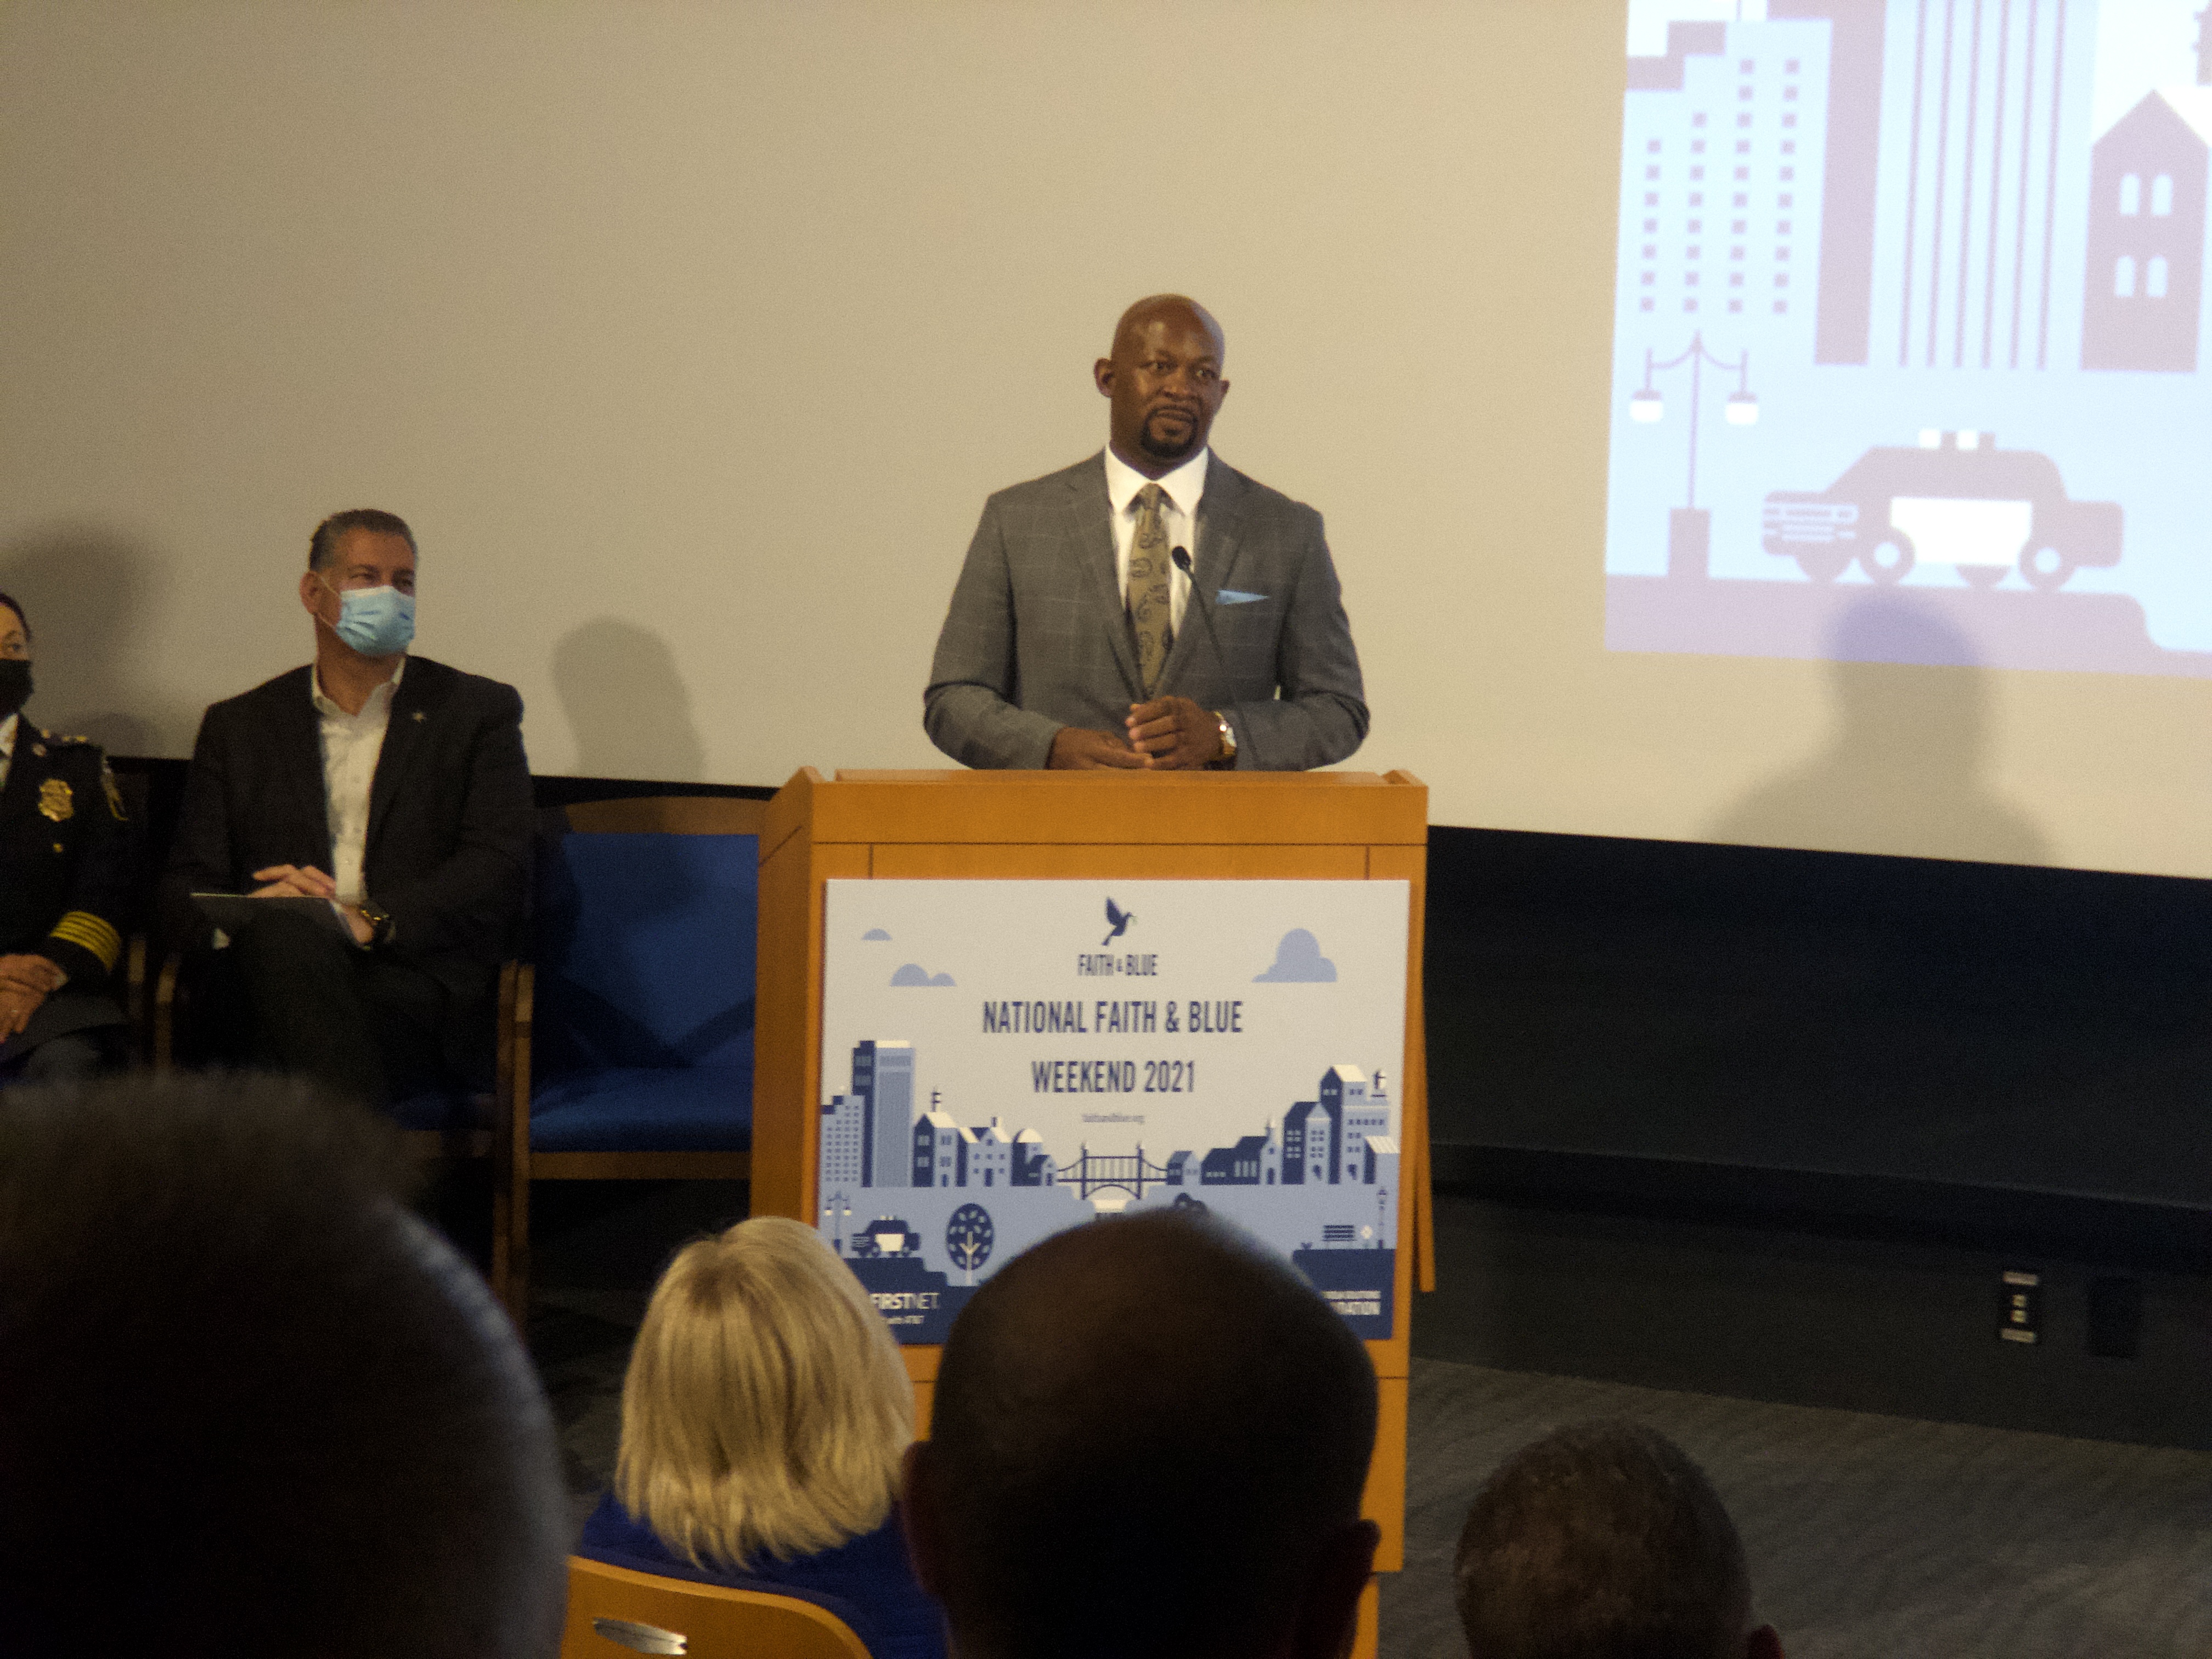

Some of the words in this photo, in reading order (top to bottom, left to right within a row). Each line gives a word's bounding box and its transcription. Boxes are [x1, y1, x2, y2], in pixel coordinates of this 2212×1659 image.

[1079, 954, 1114, 976] FAITH
[1126, 954, 1158, 976] BLUE
[983, 1001, 1087, 1033] NATIONAL
[1096, 1001, 1156, 1033] FAITH
[1166, 1001, 1180, 1033] &
[1189, 1001, 1243, 1033] BLUE
[1031, 1060, 1136, 1093] WEEKEND
[1144, 1060, 1195, 1093] 2021
